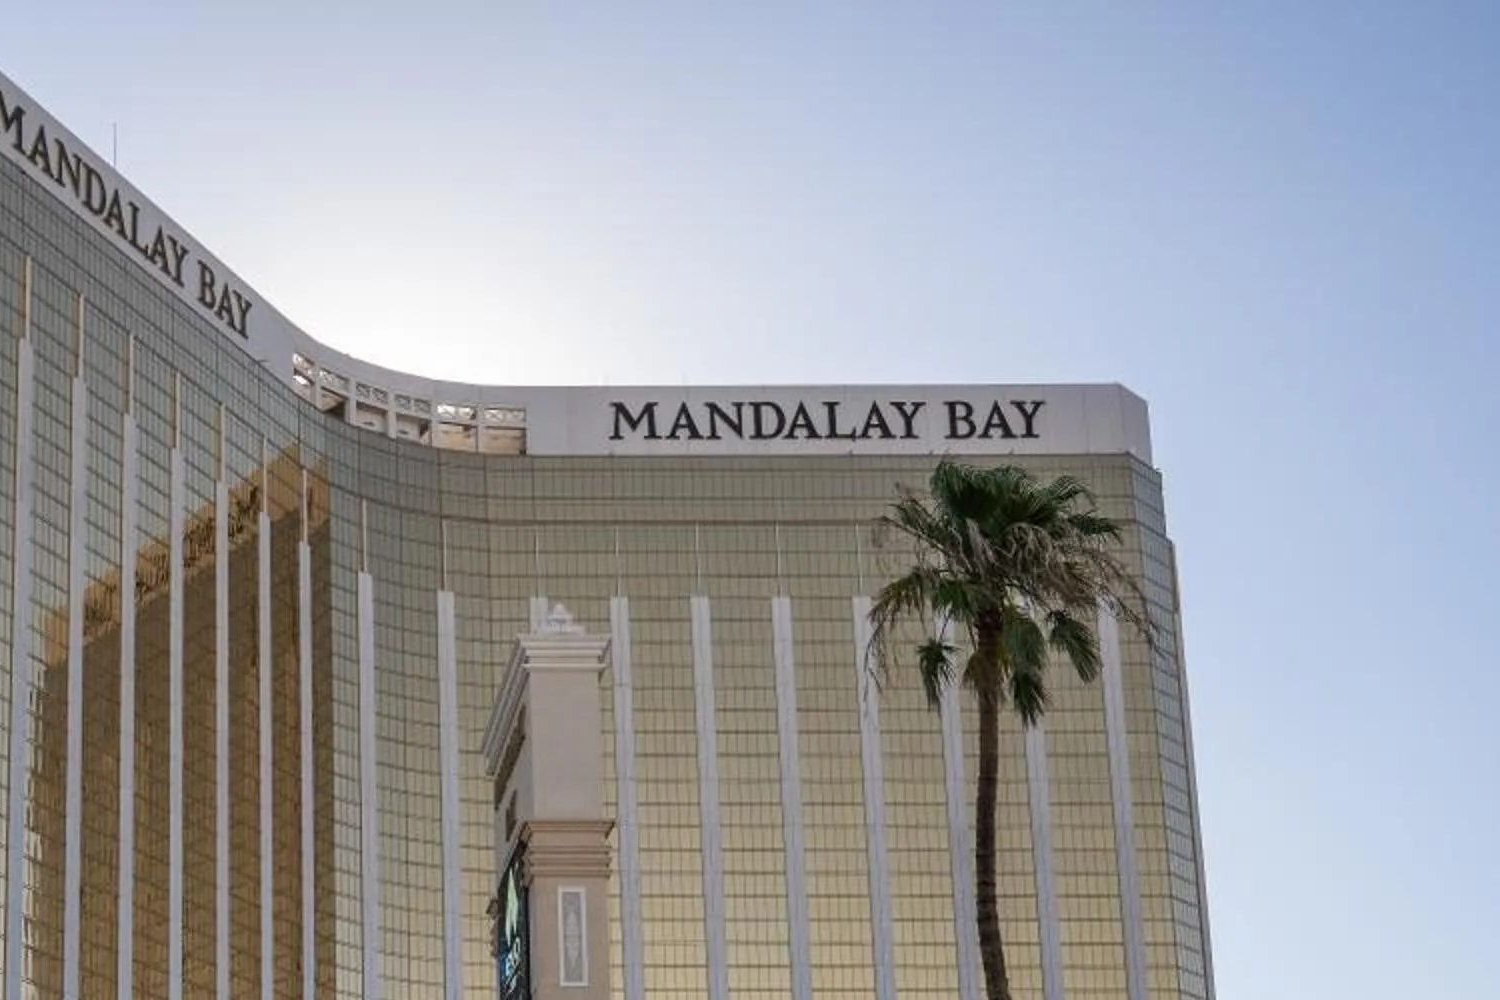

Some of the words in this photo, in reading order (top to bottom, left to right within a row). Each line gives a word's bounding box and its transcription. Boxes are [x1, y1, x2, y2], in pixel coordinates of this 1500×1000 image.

[197, 259, 253, 339] BAY
[609, 401, 926, 440] MANDALAY
[944, 400, 1045, 439] BAY
